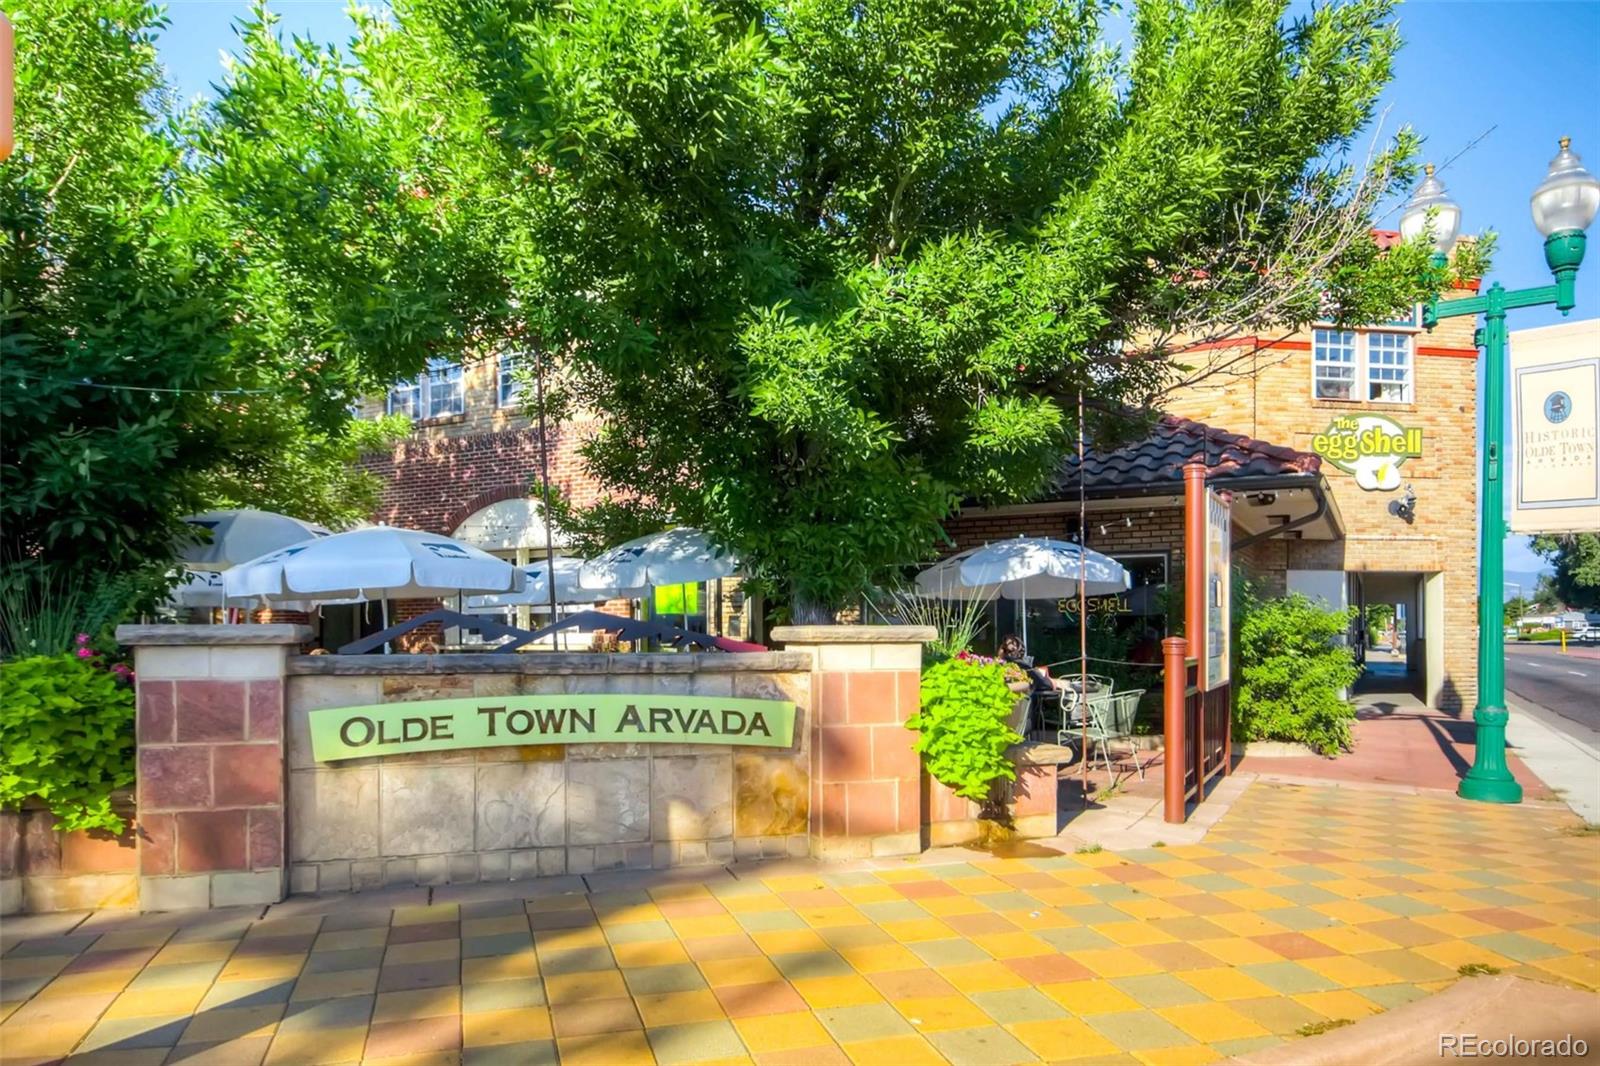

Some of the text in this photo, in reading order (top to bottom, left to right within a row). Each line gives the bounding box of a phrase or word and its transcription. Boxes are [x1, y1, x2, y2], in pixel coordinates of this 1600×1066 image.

[1334, 416, 1359, 430] The
[1525, 427, 1595, 444] HISTORIC
[1525, 441, 1594, 458] OLDE TOWN
[340, 704, 772, 747] OLDE TOWN ARVADA
